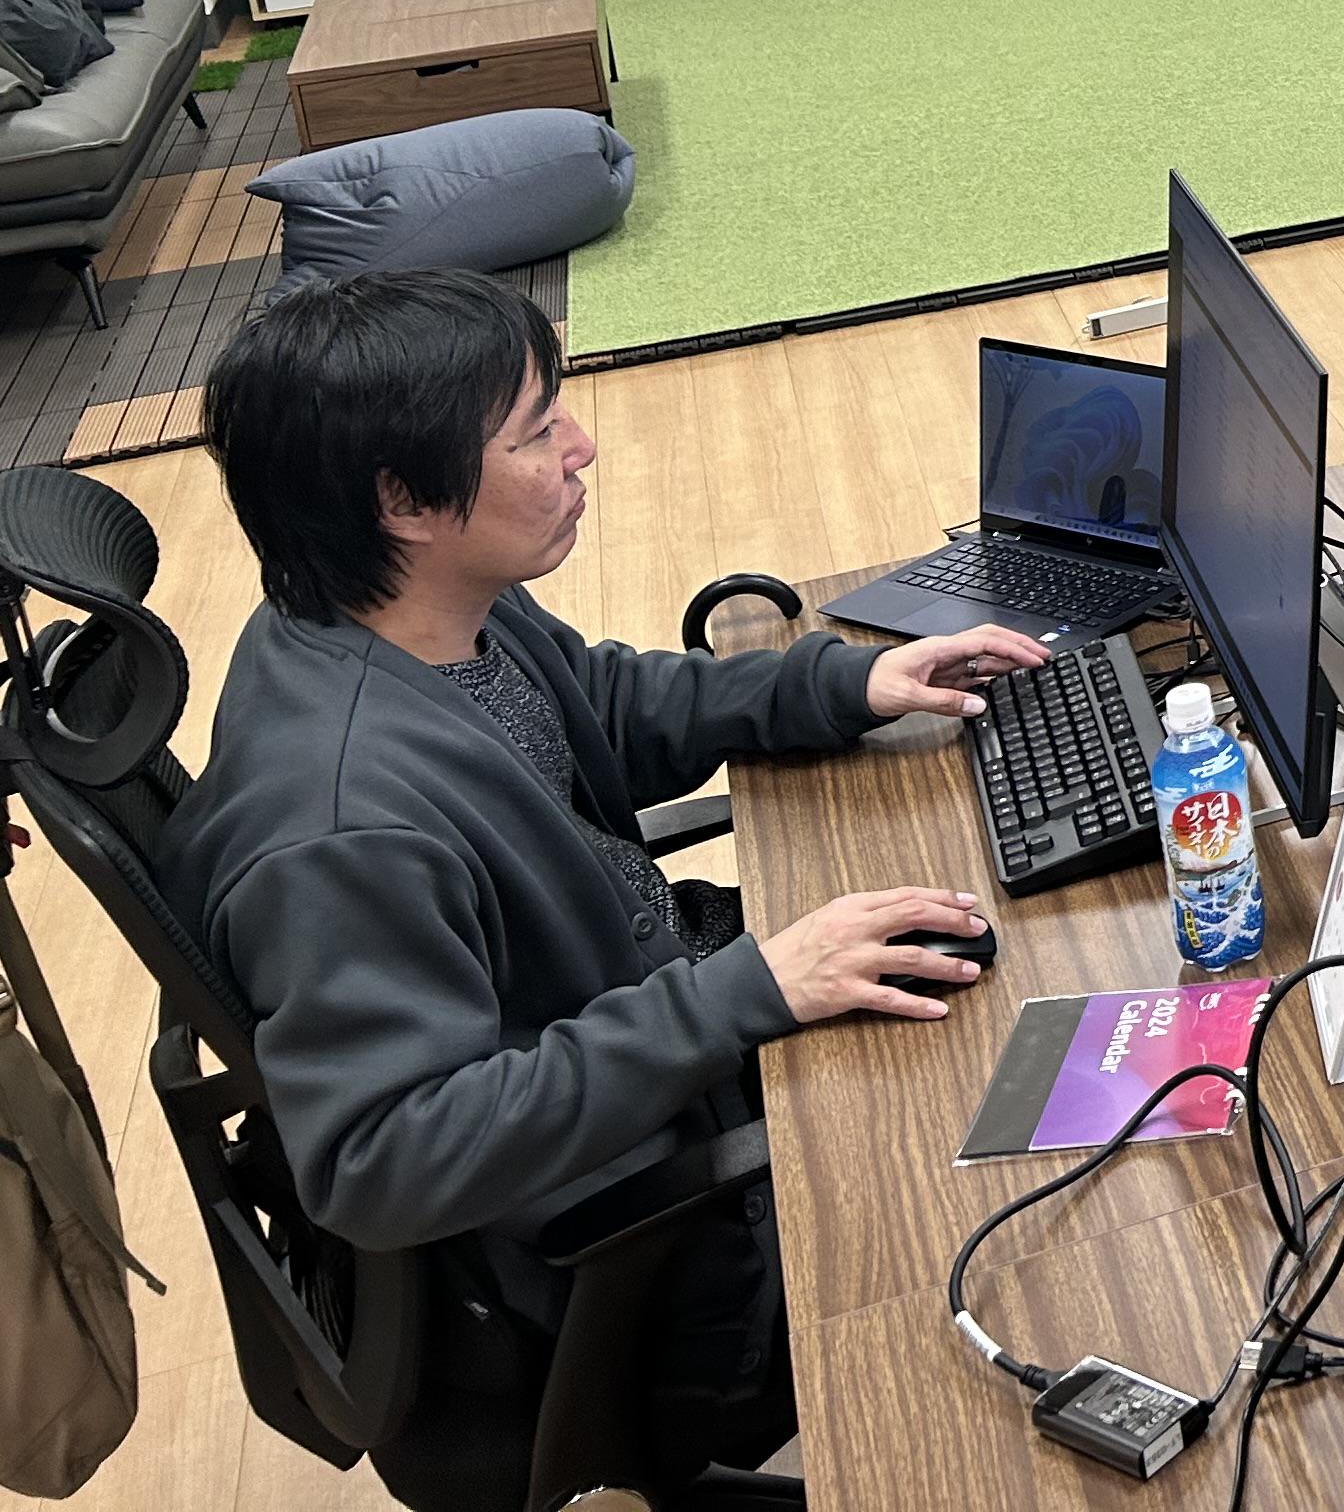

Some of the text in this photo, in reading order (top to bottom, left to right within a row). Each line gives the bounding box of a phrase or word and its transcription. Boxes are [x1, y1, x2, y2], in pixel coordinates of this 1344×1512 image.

[1181, 801, 1205, 856] サイダー
[1206, 792, 1238, 858] 日本の
[1099, 999, 1148, 1074] Calendar
[1144, 996, 1180, 1038] 2024
